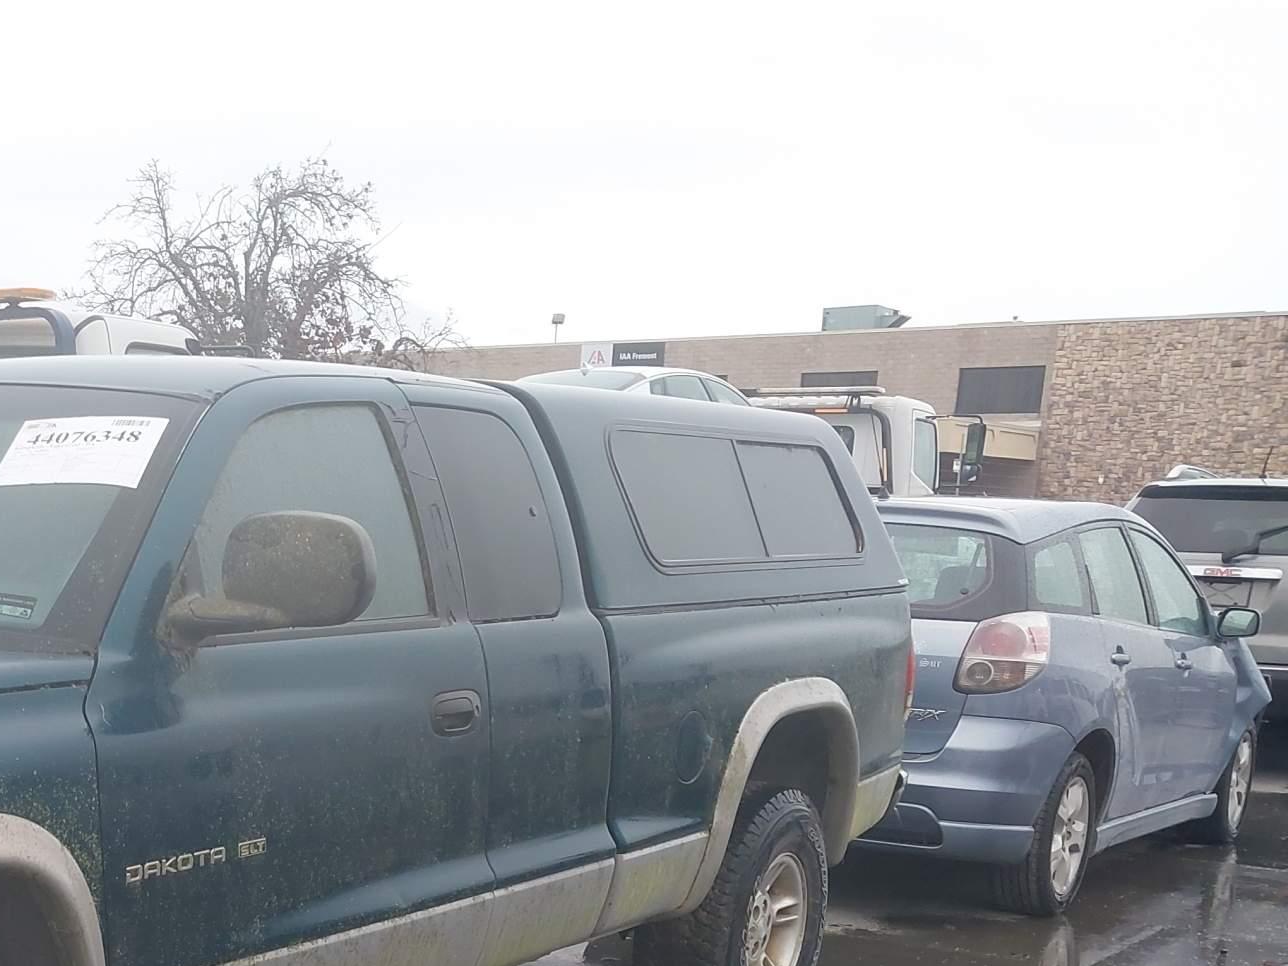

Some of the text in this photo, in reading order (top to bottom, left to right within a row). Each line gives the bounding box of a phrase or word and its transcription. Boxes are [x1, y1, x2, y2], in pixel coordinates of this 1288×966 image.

[619, 352, 631, 360] IAA
[26, 430, 143, 446] 44076348
[1204, 567, 1242, 576] GMC
[125, 841, 266, 884] DAKOTA SLT
